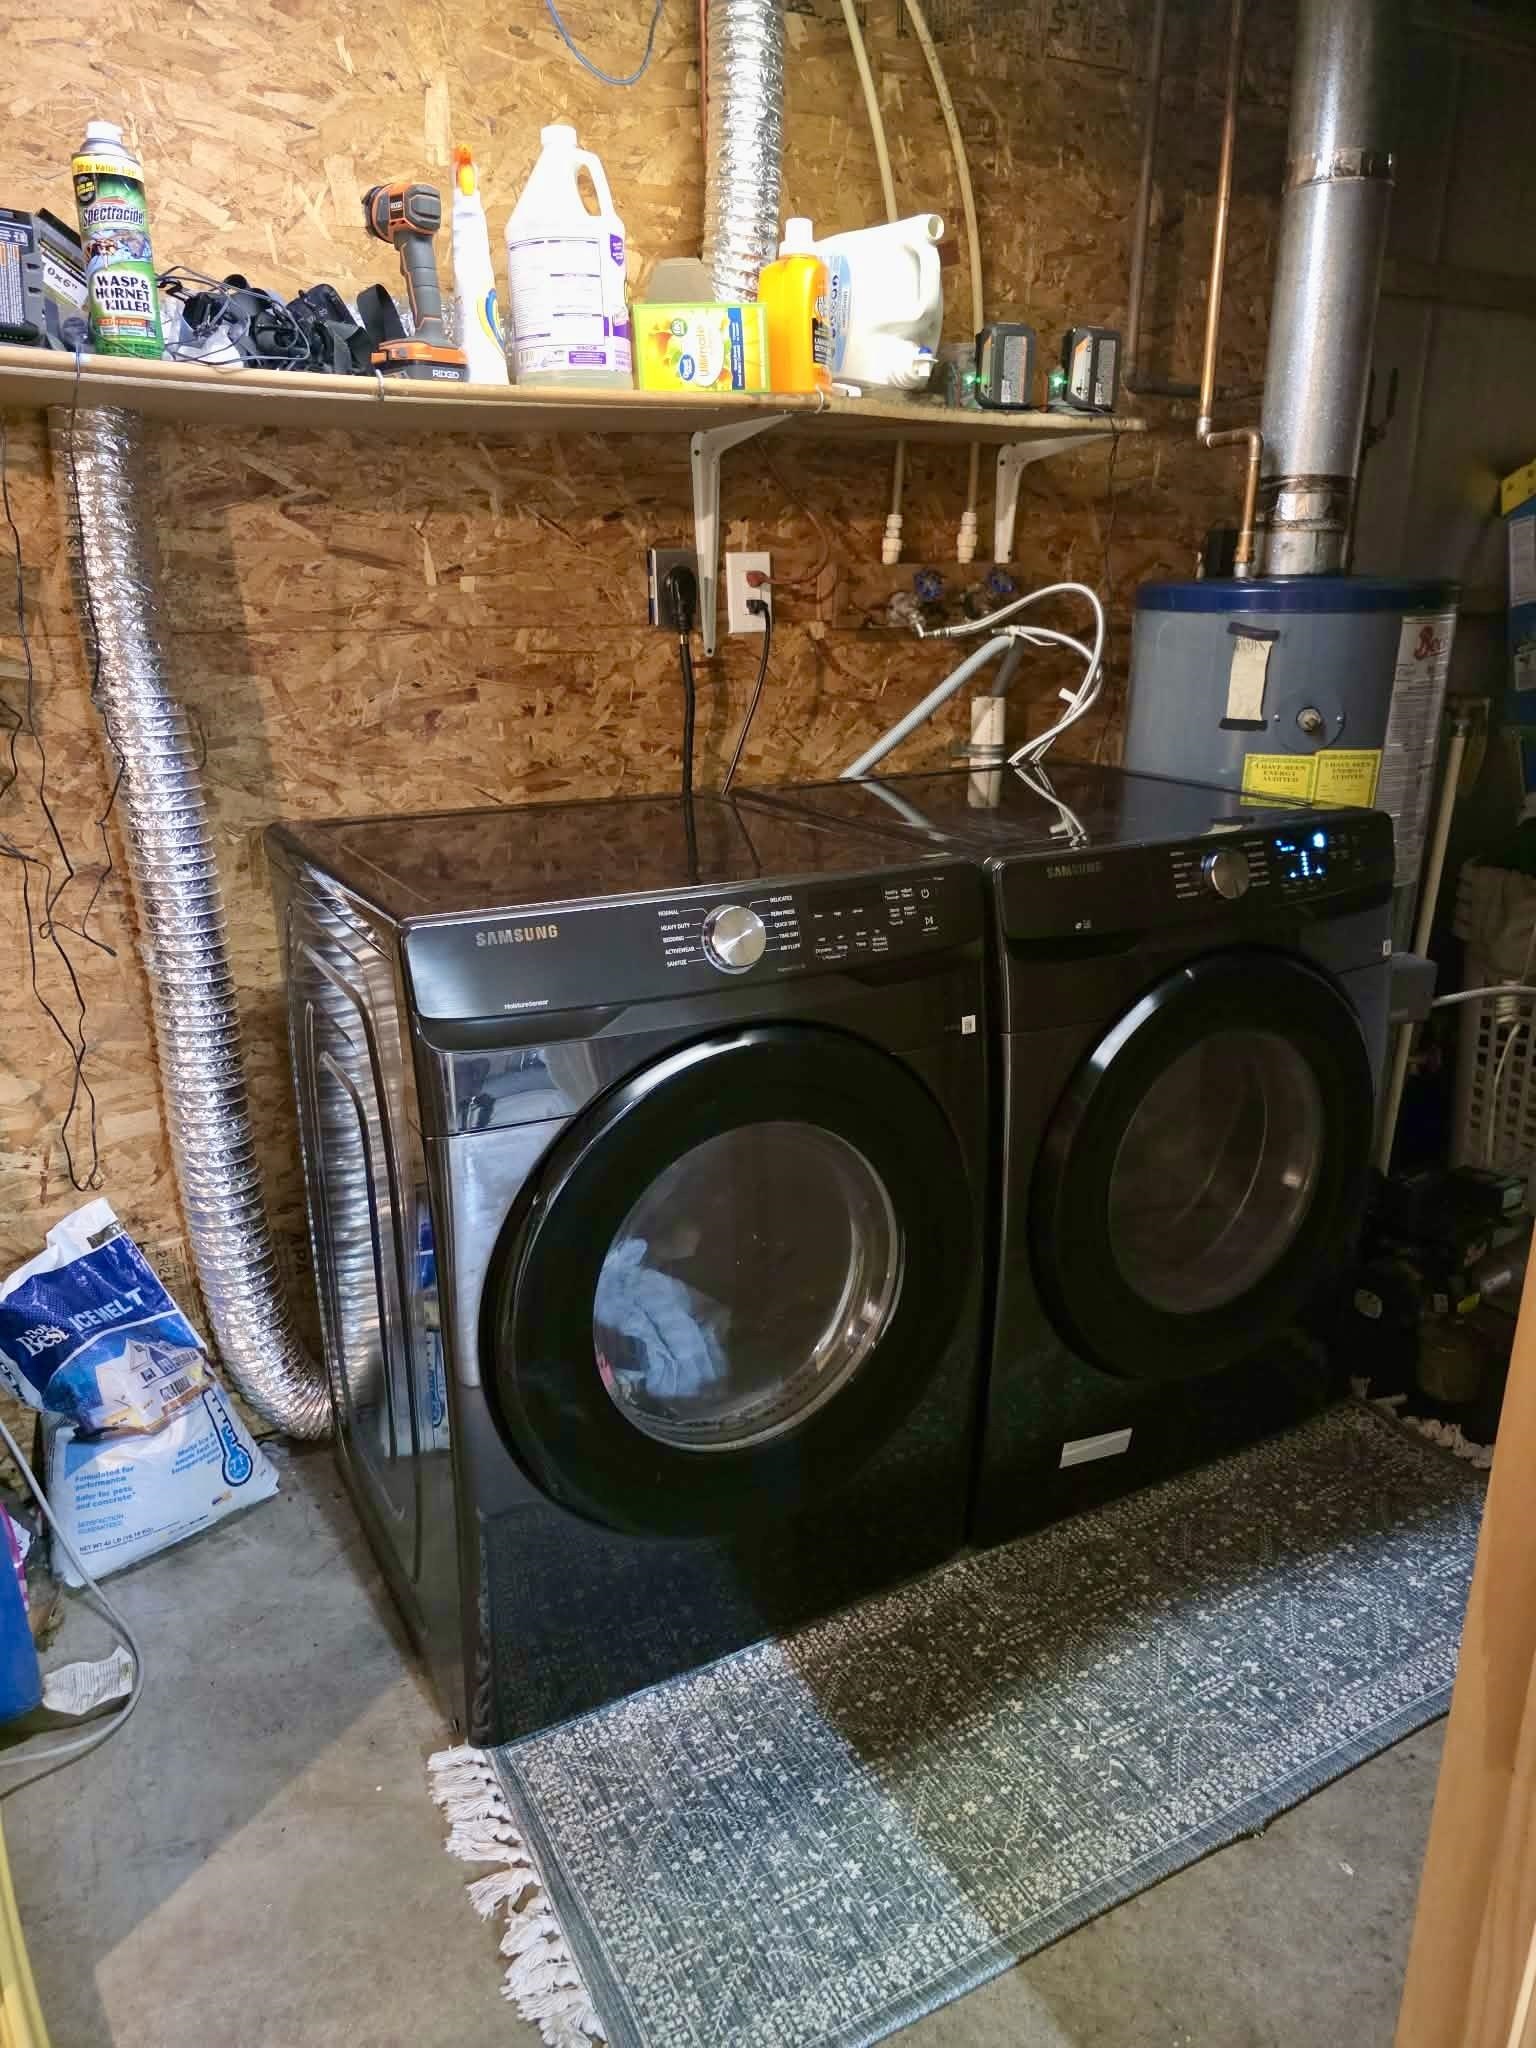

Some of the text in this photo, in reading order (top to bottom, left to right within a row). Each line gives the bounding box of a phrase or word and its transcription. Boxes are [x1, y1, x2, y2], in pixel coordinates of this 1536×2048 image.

[83, 206, 144, 228] Spectracide
[97, 275, 148, 289] WASP &
[95, 287, 149, 301] HORNET
[105, 300, 152, 313] KILLER
[432, 369, 461, 380] RIDGID
[475, 924, 558, 947] SAMSUNG
[665, 945, 696, 955] ACTIVEWEAR
